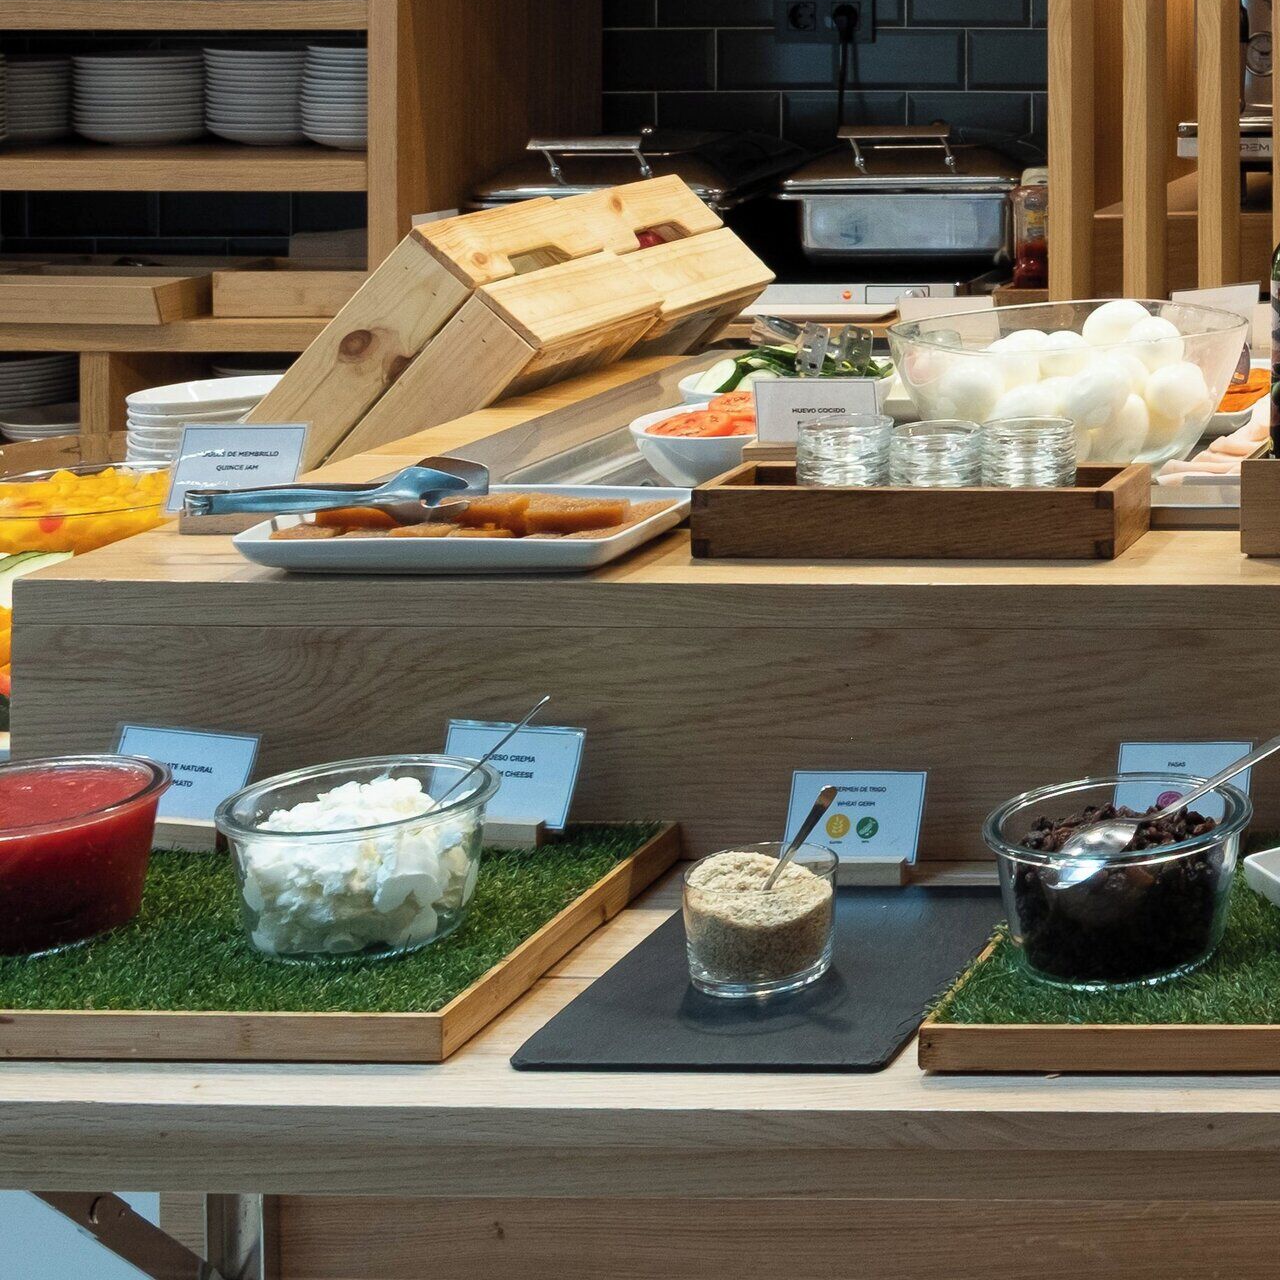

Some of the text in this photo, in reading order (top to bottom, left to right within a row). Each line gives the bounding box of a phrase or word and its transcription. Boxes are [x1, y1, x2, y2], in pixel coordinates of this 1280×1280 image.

[510, 754, 536, 763] CREMA
[180, 763, 213, 774] NATURAL
[504, 770, 534, 779] CHEESE
